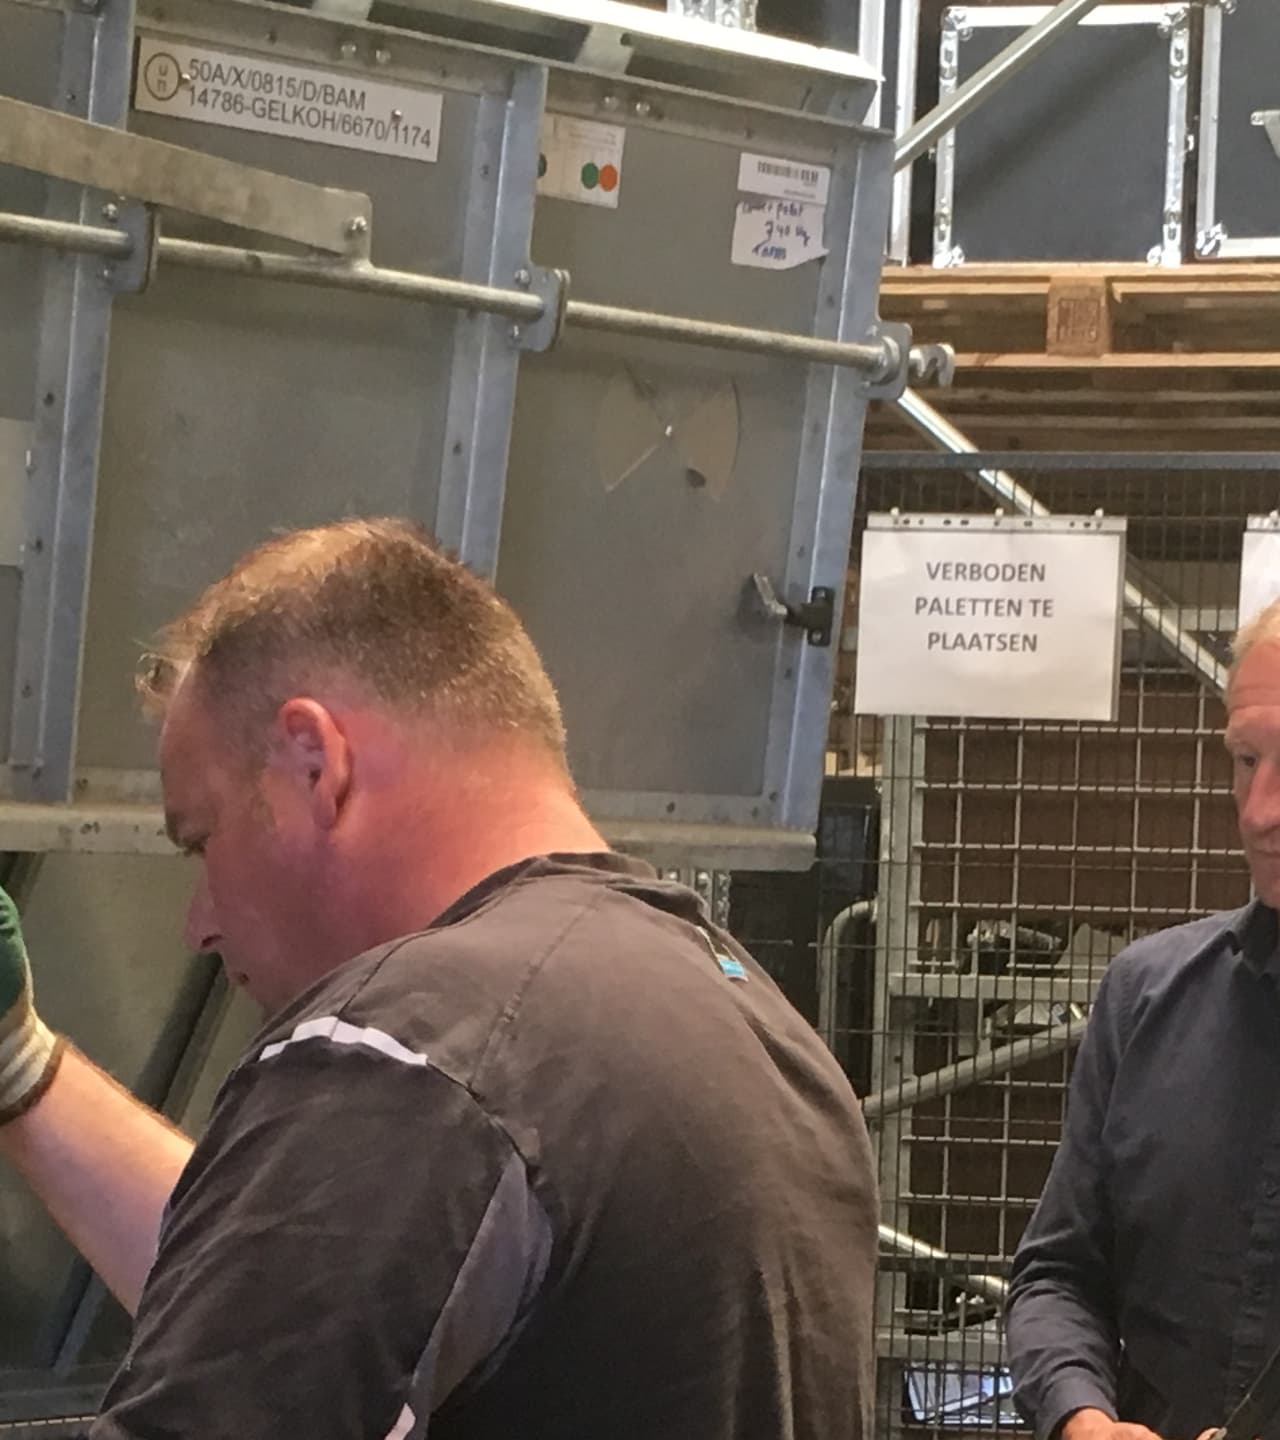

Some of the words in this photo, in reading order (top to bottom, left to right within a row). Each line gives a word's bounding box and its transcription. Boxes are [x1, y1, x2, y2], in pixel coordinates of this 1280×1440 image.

[188, 58, 367, 111] 50A/X/0815/D/BAM
[187, 85, 432, 149] 14786-GELKOH/6670/1174
[926, 561, 1046, 582] VERBODEN
[915, 596, 1023, 618] PALETTEN
[1028, 598, 1055, 618] TE
[927, 631, 1038, 652] PLAATSEN
